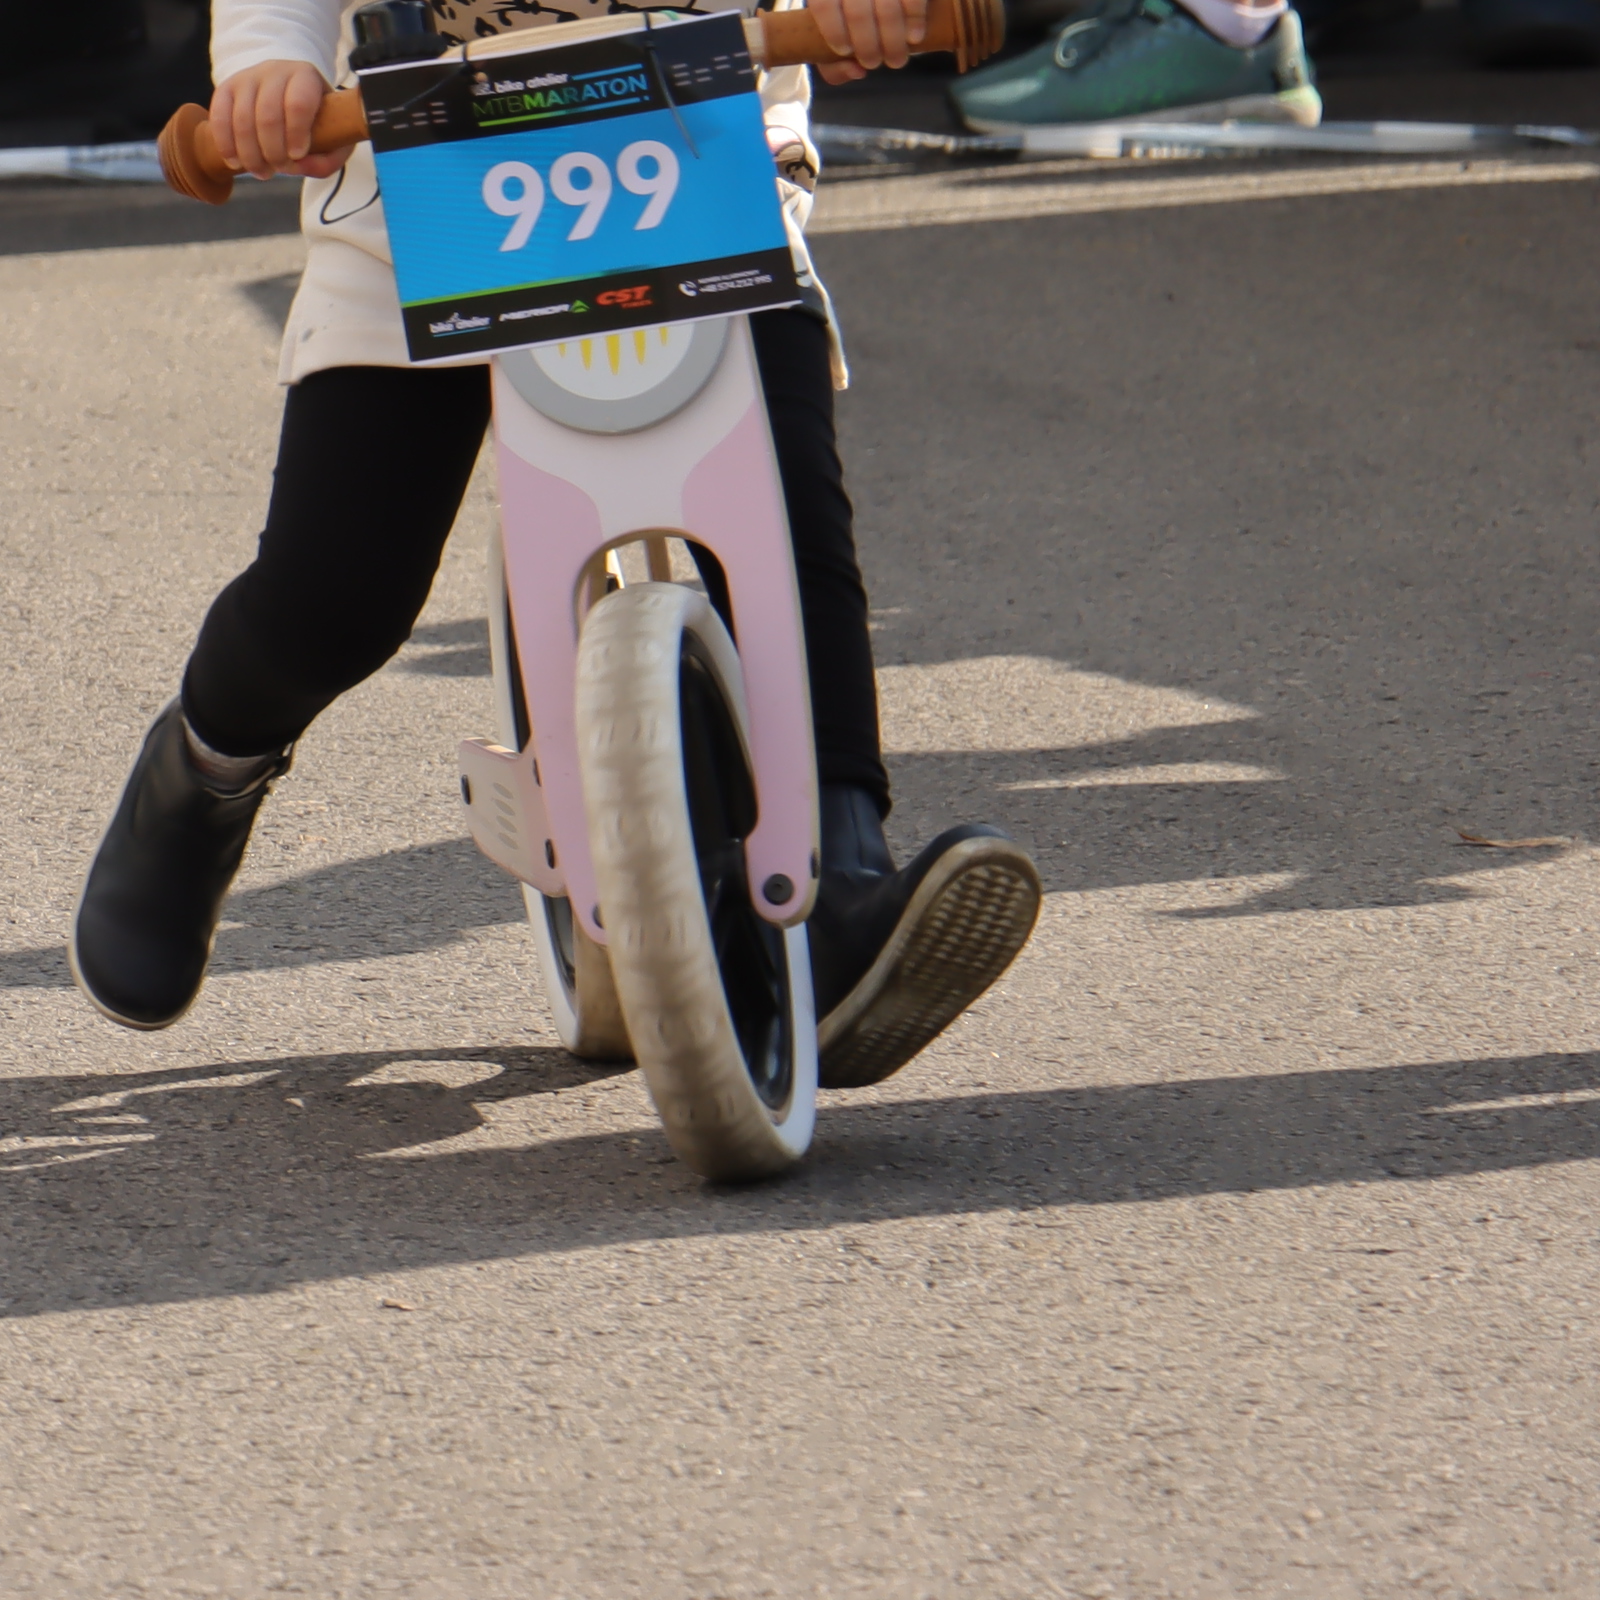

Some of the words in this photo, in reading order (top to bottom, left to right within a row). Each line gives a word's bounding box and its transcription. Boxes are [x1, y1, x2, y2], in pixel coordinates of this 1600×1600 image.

[472, 74, 648, 117] MTBMARATON
[494, 81, 524, 93] bike
[526, 73, 568, 88] atelier
[482, 139, 680, 252] 999
[596, 285, 650, 305] CST
